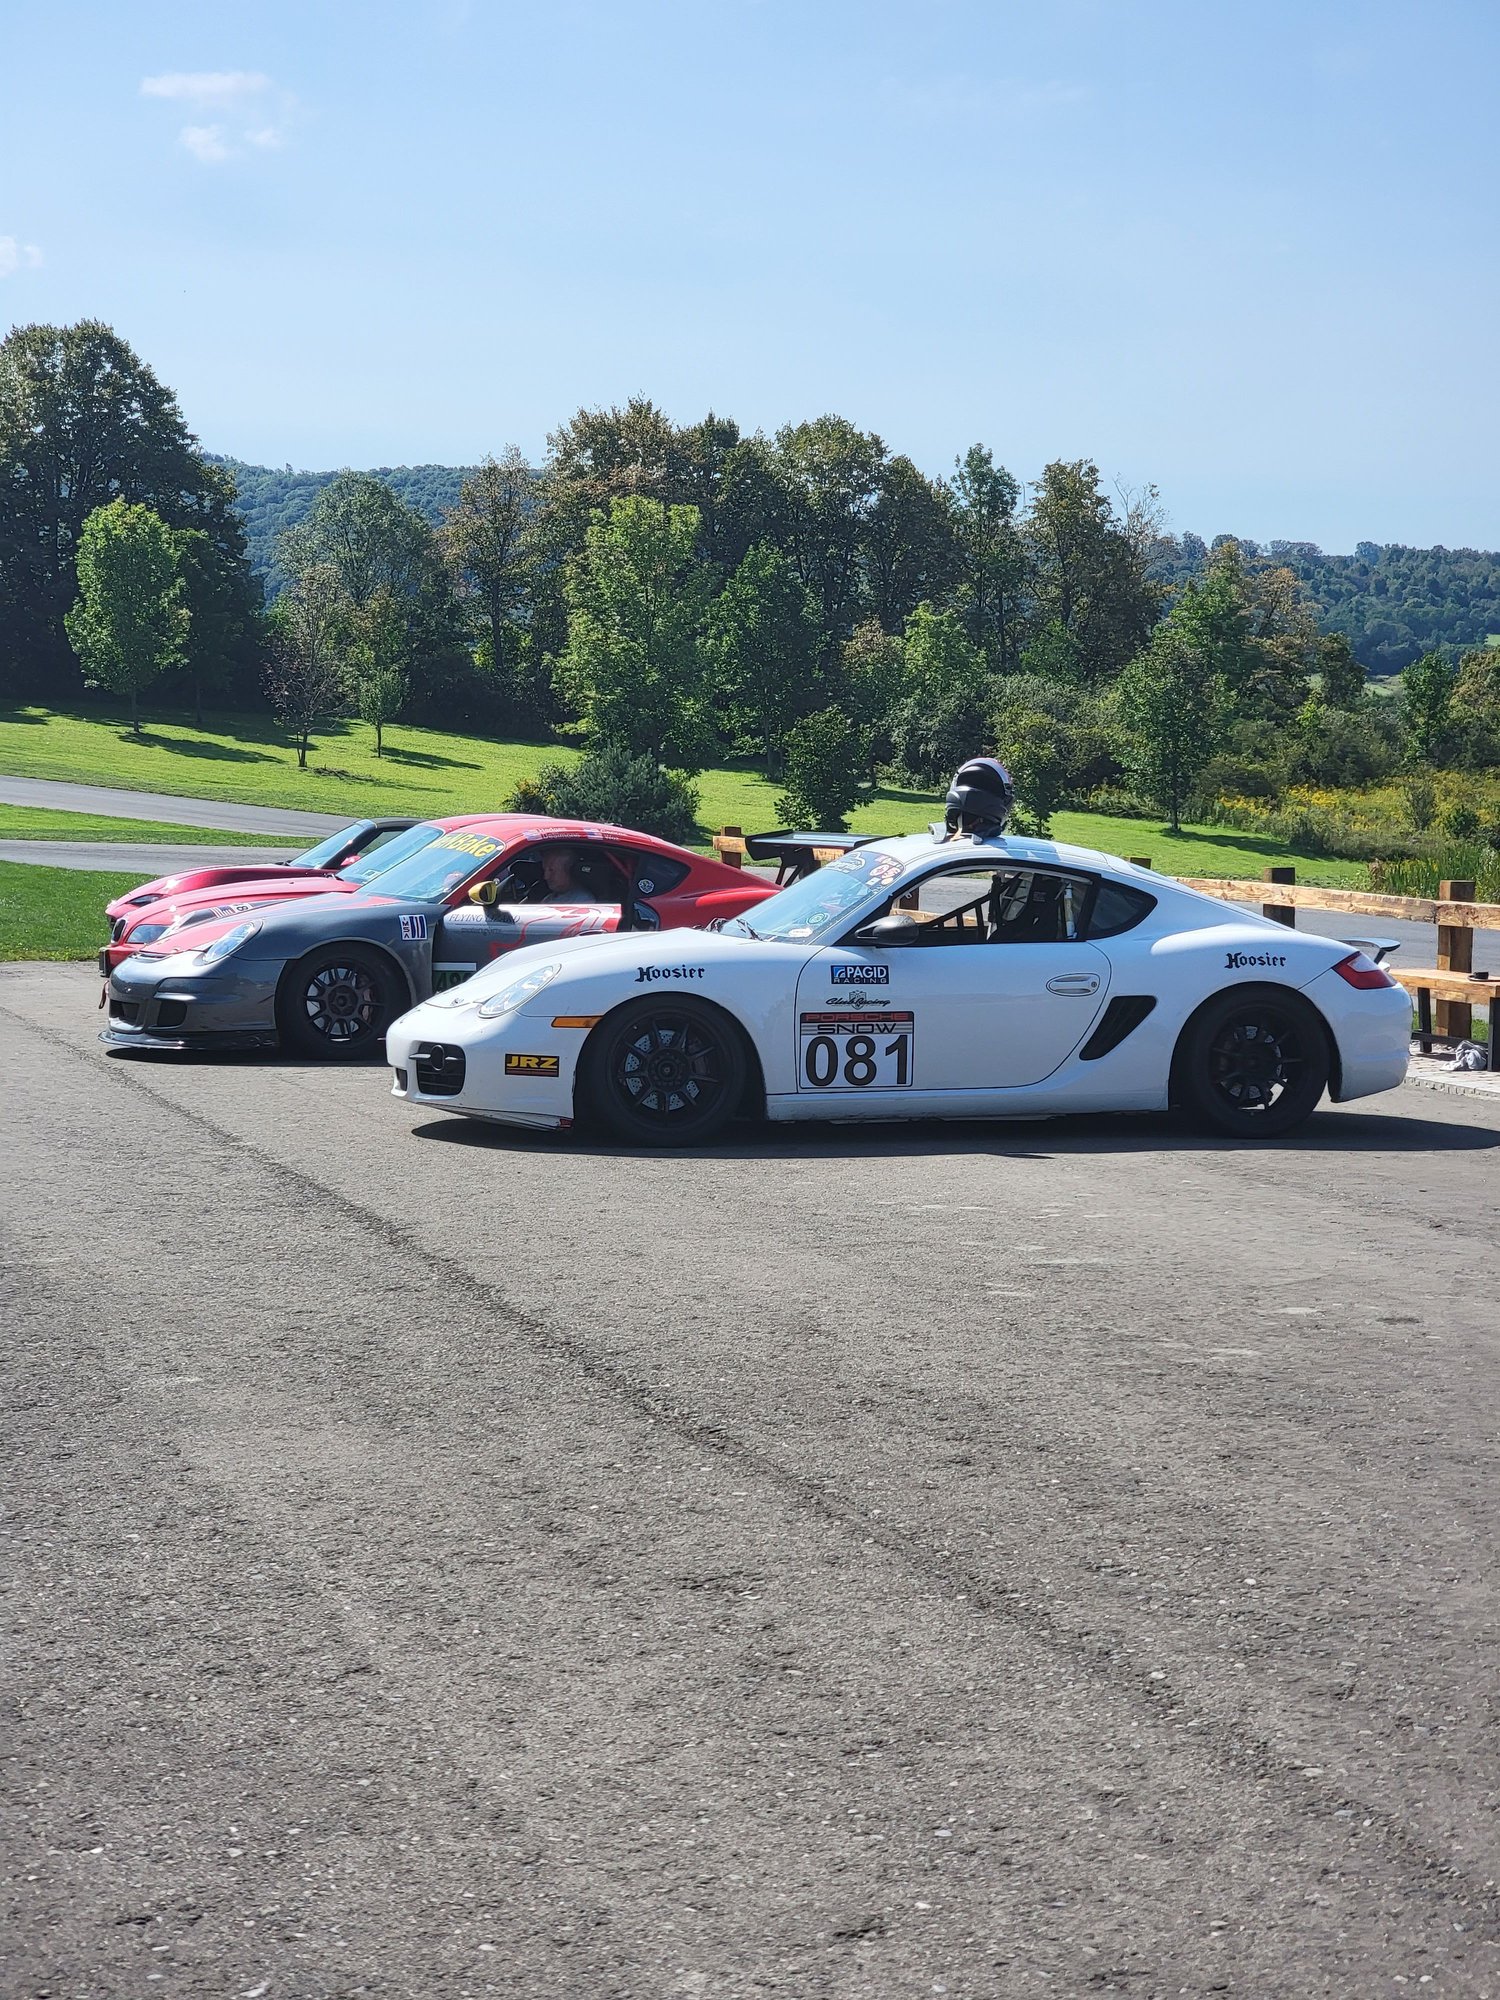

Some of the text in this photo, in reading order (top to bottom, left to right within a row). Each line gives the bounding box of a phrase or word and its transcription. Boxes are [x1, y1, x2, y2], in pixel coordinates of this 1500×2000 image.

[401, 916, 411, 939] IMSA
[1224, 951, 1287, 969] Hoosier
[634, 964, 705, 982] Hoosier
[847, 966, 887, 978] PAGID
[805, 1013, 909, 1022] PORSCHE
[817, 1023, 897, 1034] SNOW
[506, 1055, 558, 1069] JRZ
[805, 1034, 908, 1087] 081
